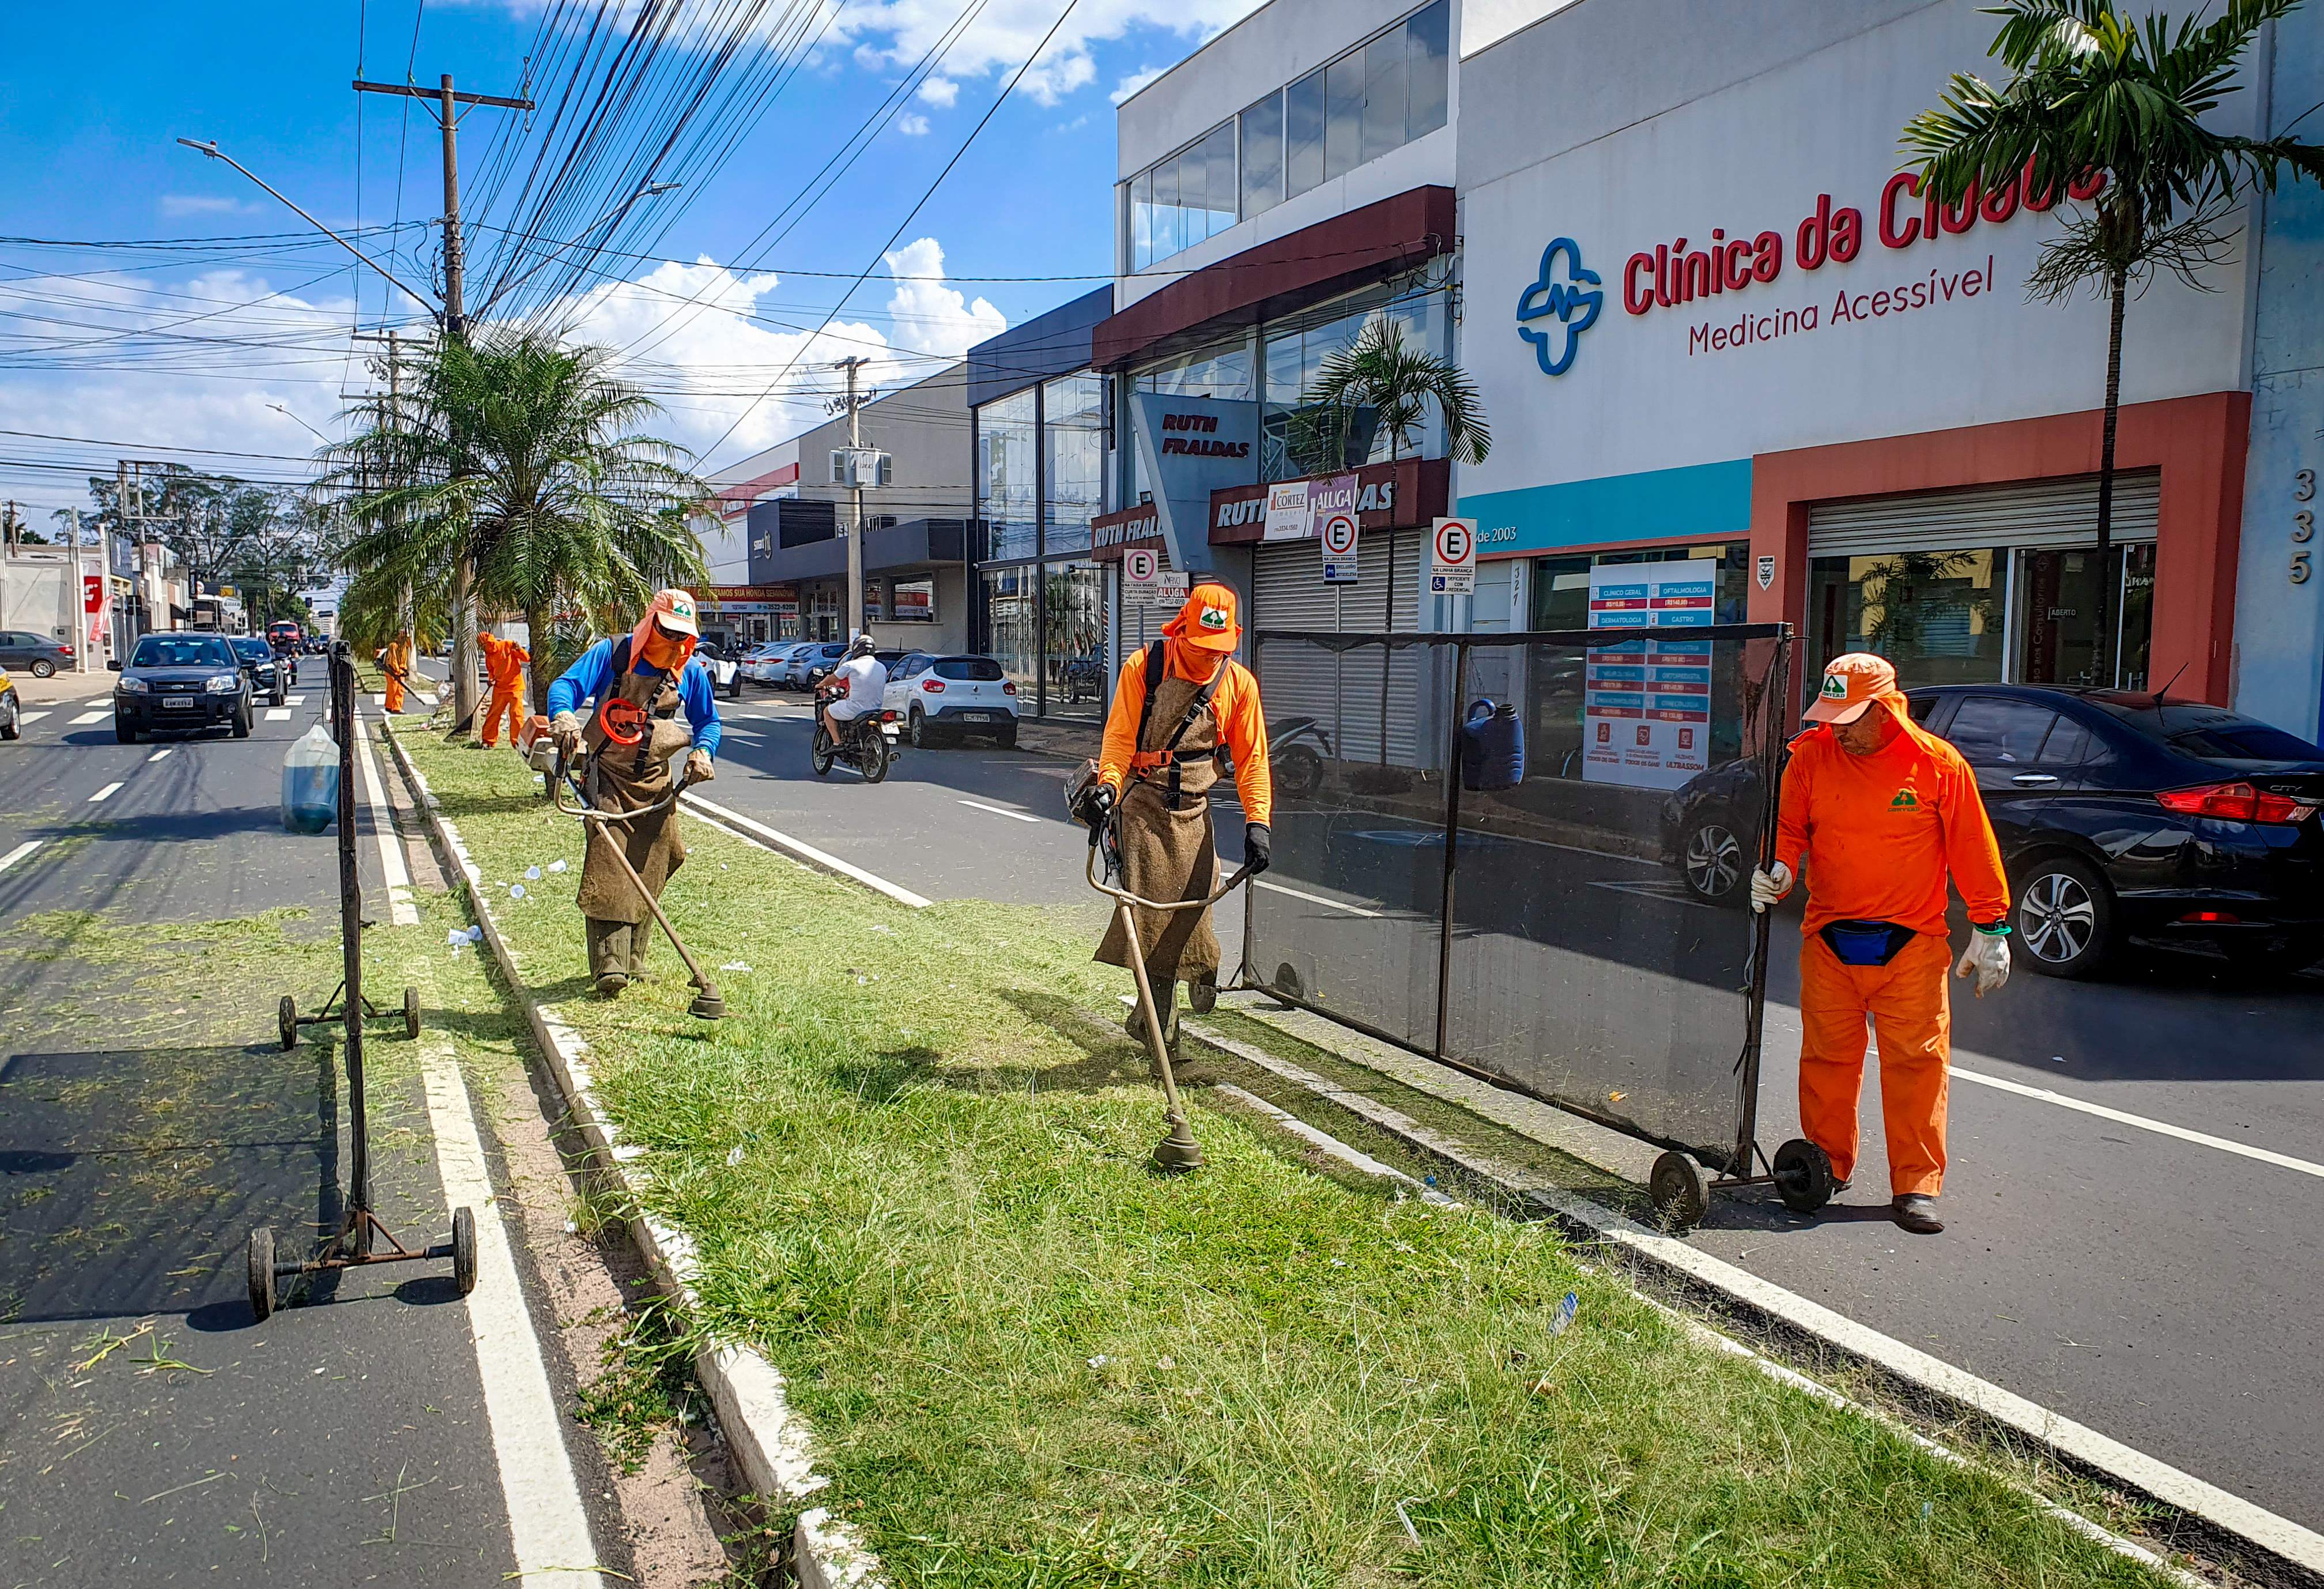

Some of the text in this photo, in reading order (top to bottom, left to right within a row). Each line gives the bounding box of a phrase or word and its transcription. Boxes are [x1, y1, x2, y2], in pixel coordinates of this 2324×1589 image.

[1623, 228, 1783, 316] Clínica
[1795, 193, 1862, 270] da
[1688, 254, 1993, 356] Medicina Acessível
[1162, 413, 1218, 432] RUTH
[1162, 438, 1250, 458] FRALDAS
[1277, 494, 1305, 507] CORTEZ
[1316, 489, 1352, 509] ALUGA
[1094, 523, 1125, 548] RUTH
[1334, 525, 1345, 544] E
[1492, 526, 1516, 542] 2003
[1447, 532, 1461, 555] E
[1136, 557, 1146, 574] E
[734, 589, 745, 597] SUA
[746, 589, 765, 598] HONDA
[1158, 588, 1186, 597] ALUGA
[1663, 586, 1706, 594] OFTALMOLOGIA
[2051, 608, 2076, 616] ABERTO
[1666, 760, 1705, 771] ULTRASSOM
